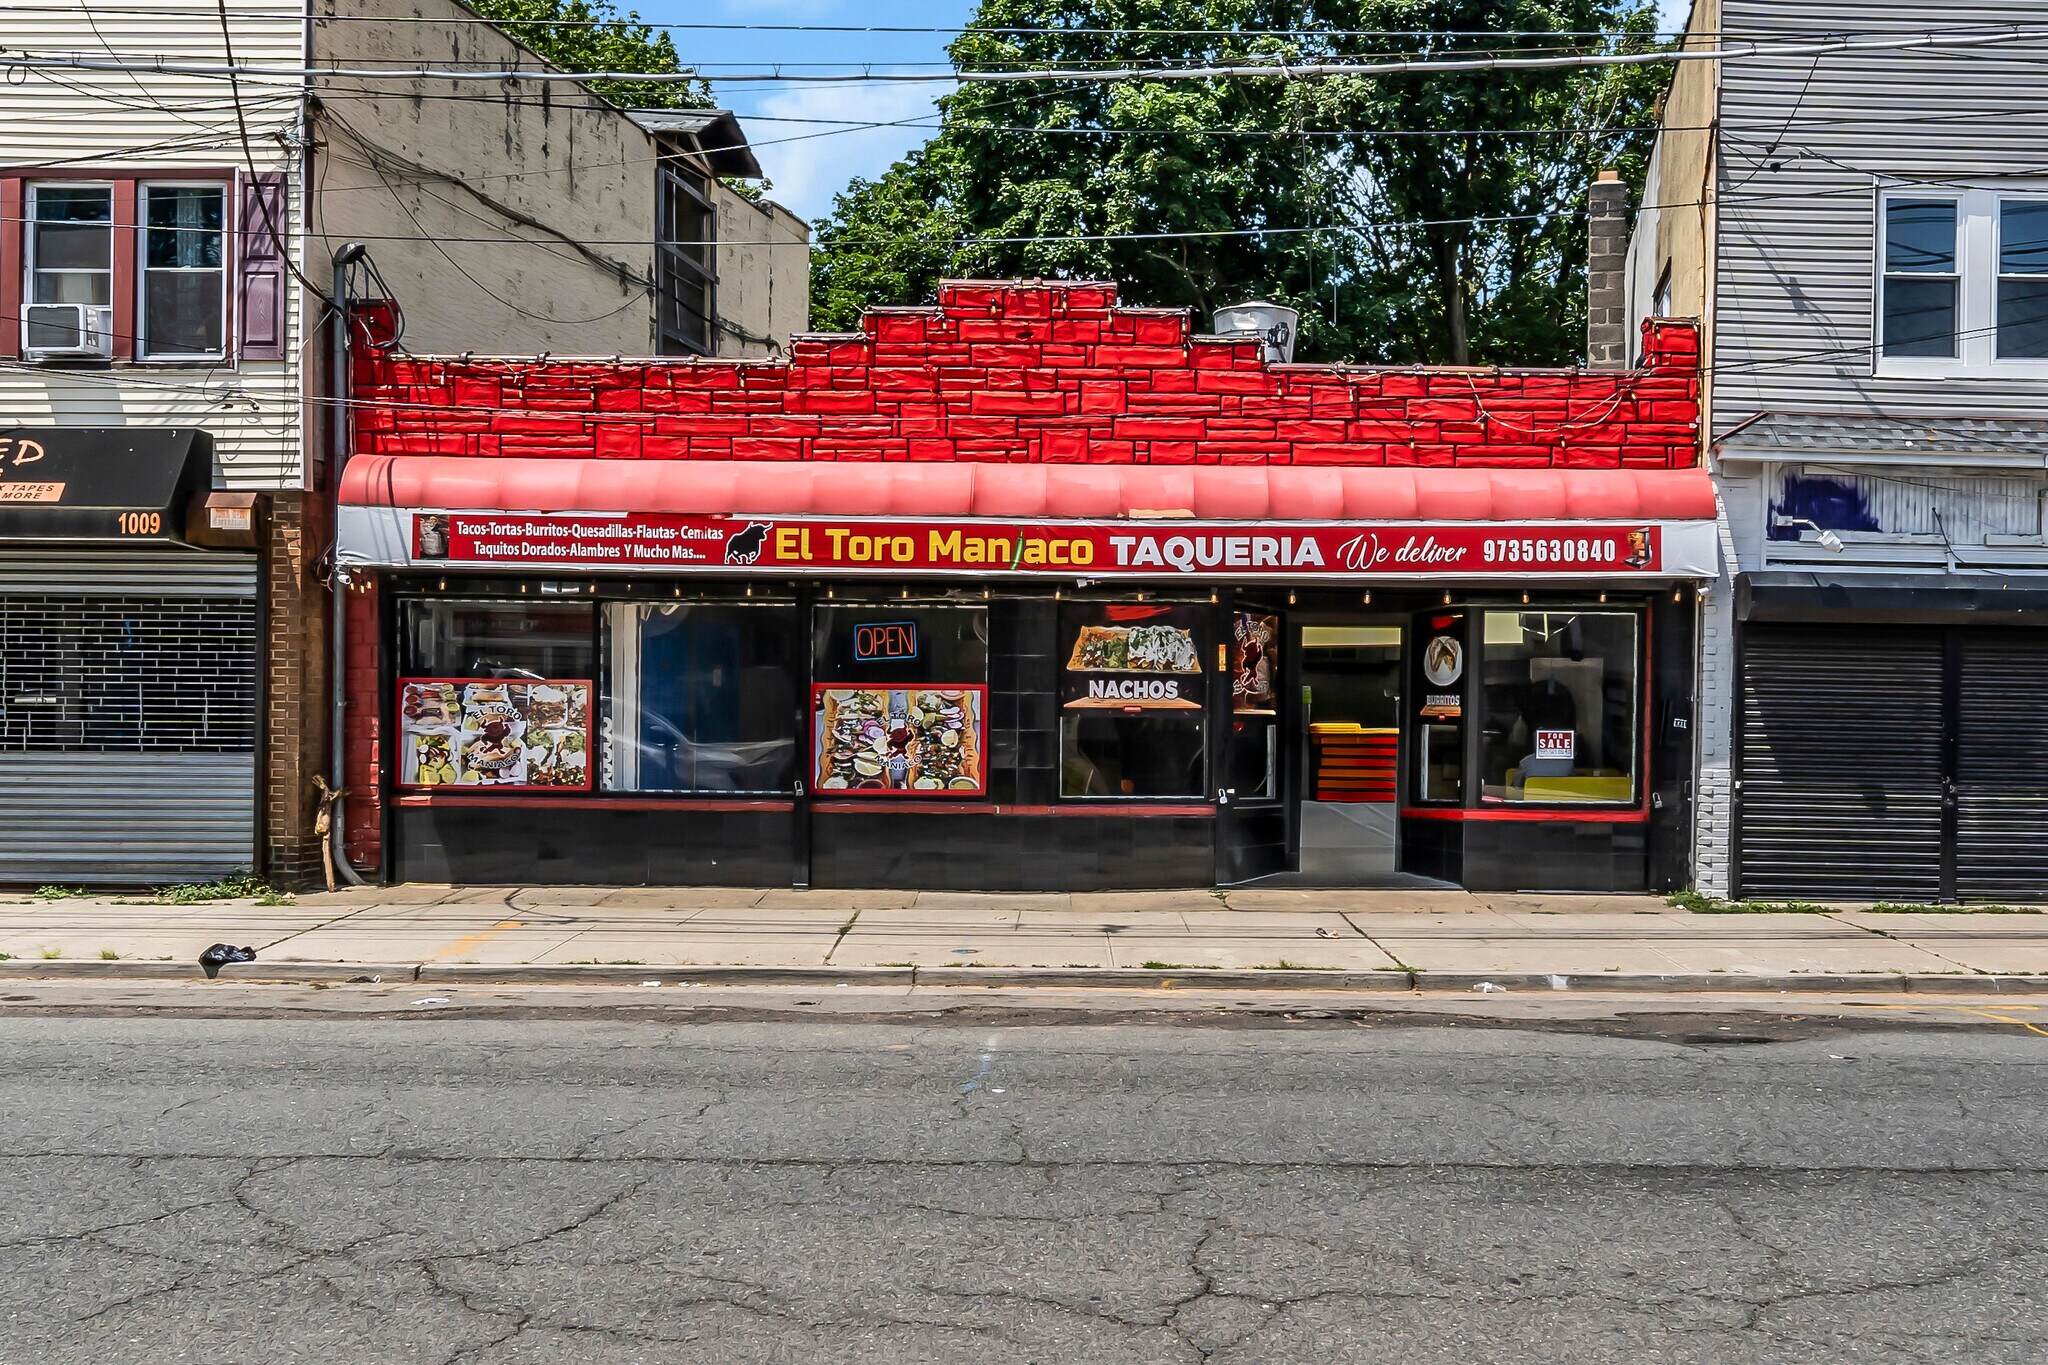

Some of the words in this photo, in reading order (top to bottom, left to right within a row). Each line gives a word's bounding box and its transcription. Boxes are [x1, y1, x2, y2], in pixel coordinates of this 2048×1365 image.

[11, 484, 55, 492] TAPES
[118, 512, 161, 535] 1009
[473, 541, 520, 558] Taquitos
[521, 541, 621, 558] Dorados-Alambres
[624, 543, 632, 558] Y
[633, 543, 670, 559] Mucho
[775, 527, 813, 560] El
[824, 528, 915, 562] Toro
[1336, 533, 1390, 570] We
[1394, 536, 1467, 563] deliver
[1483, 539, 1616, 562] 9735630840
[1109, 536, 1326, 572] TAQUERIA
[857, 625, 914, 656] OPEN
[1089, 680, 1179, 699] NACHOS
[1426, 695, 1460, 706] BURRITOS
[472, 708, 488, 720] EL
[488, 705, 522, 721] TORO
[891, 712, 922, 728] TORO
[1539, 739, 1571, 749] SALE
[467, 753, 522, 769] MANIACO
[873, 755, 923, 770] MANIACO
